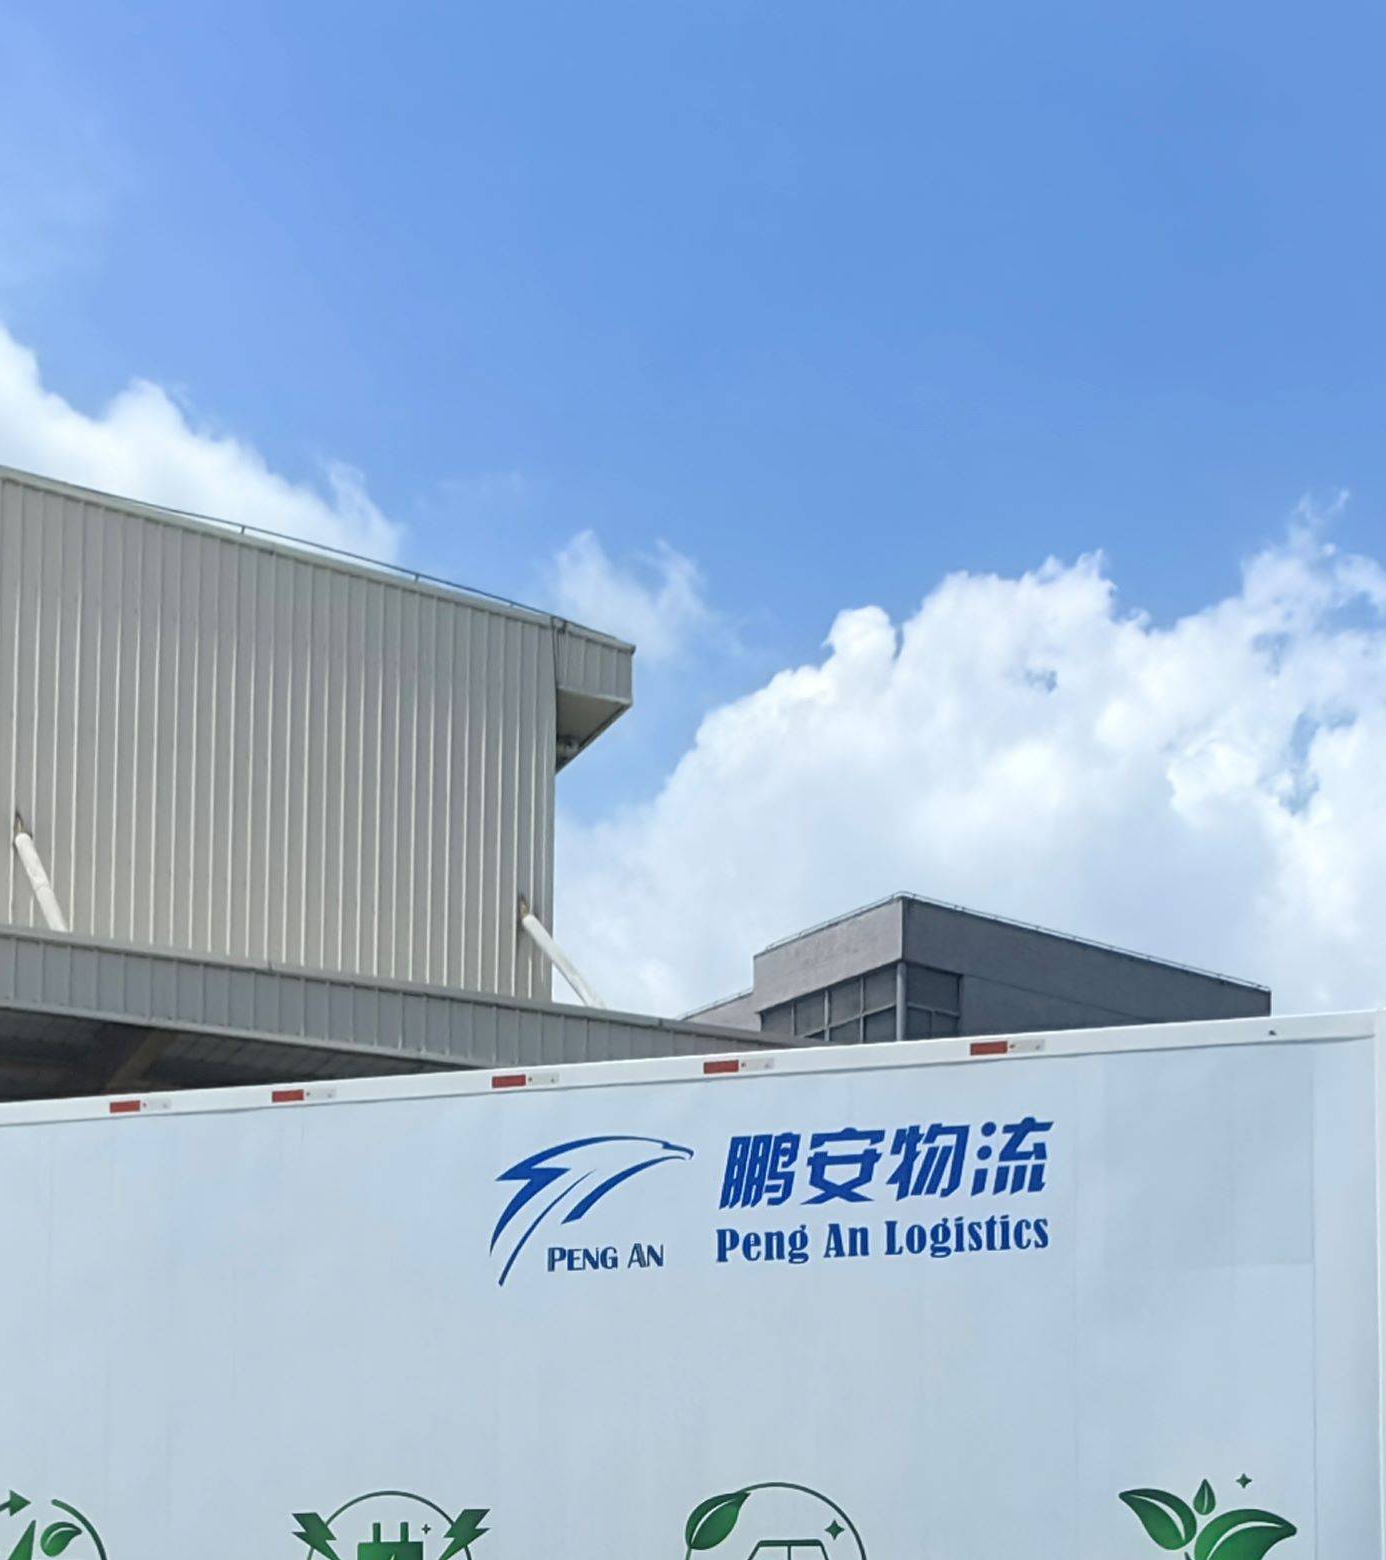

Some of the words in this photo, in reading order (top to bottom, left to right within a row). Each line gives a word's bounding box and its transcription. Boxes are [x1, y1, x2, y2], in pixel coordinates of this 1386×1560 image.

[718, 1117, 1054, 1210] 鹏安物流
[547, 1246, 618, 1273] PENG
[627, 1243, 665, 1269] AN
[716, 1227, 810, 1264] Peng
[824, 1223, 870, 1258] An
[885, 1215, 1050, 1258] Logistics
